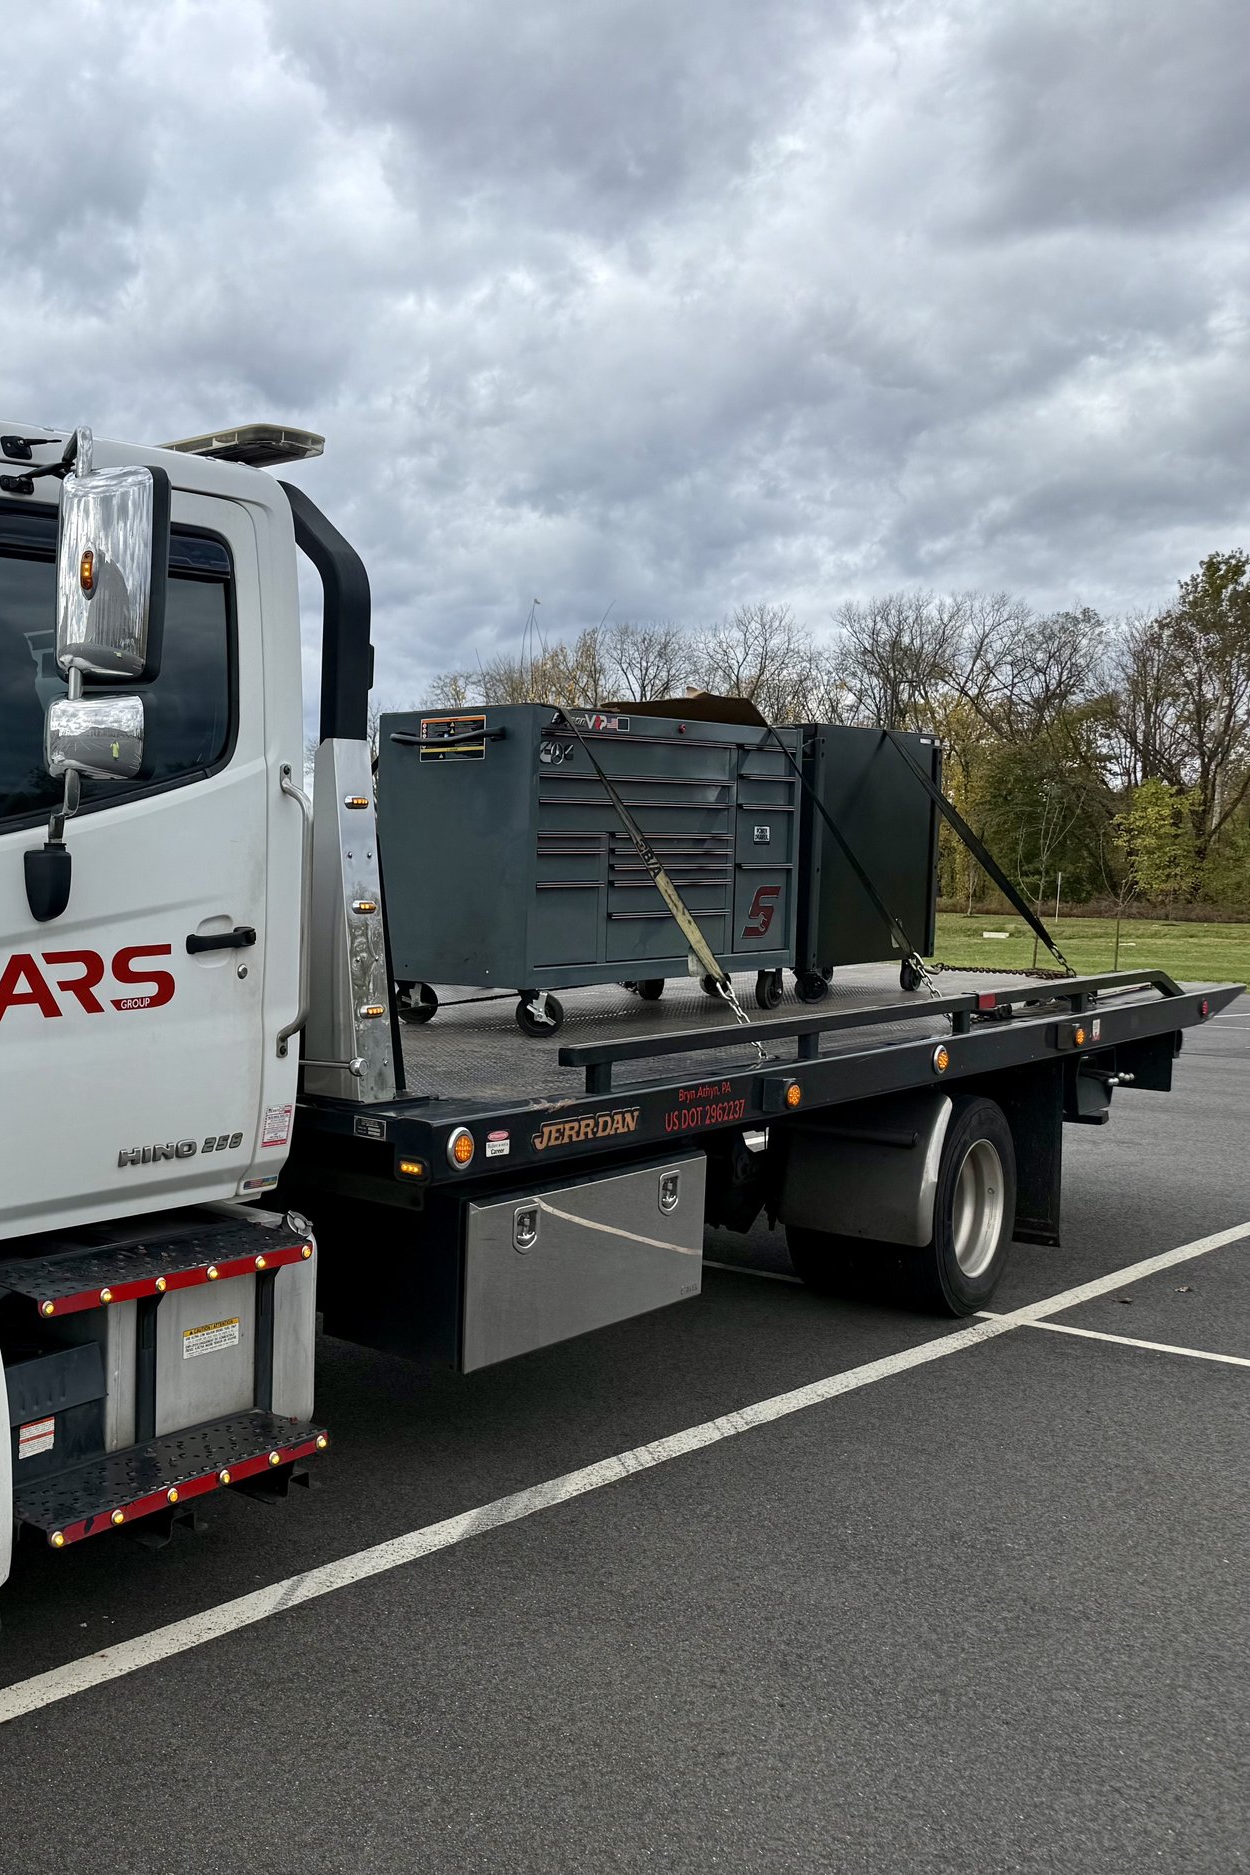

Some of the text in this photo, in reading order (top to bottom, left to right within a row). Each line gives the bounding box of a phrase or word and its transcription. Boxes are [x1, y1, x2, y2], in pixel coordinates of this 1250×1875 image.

[120, 997, 151, 1009] GROUP
[678, 1089, 696, 1103] Bryn
[721, 1081, 732, 1094] PA
[665, 1099, 746, 1132] US DOT 2962237
[117, 1132, 244, 1168] HINO 258
